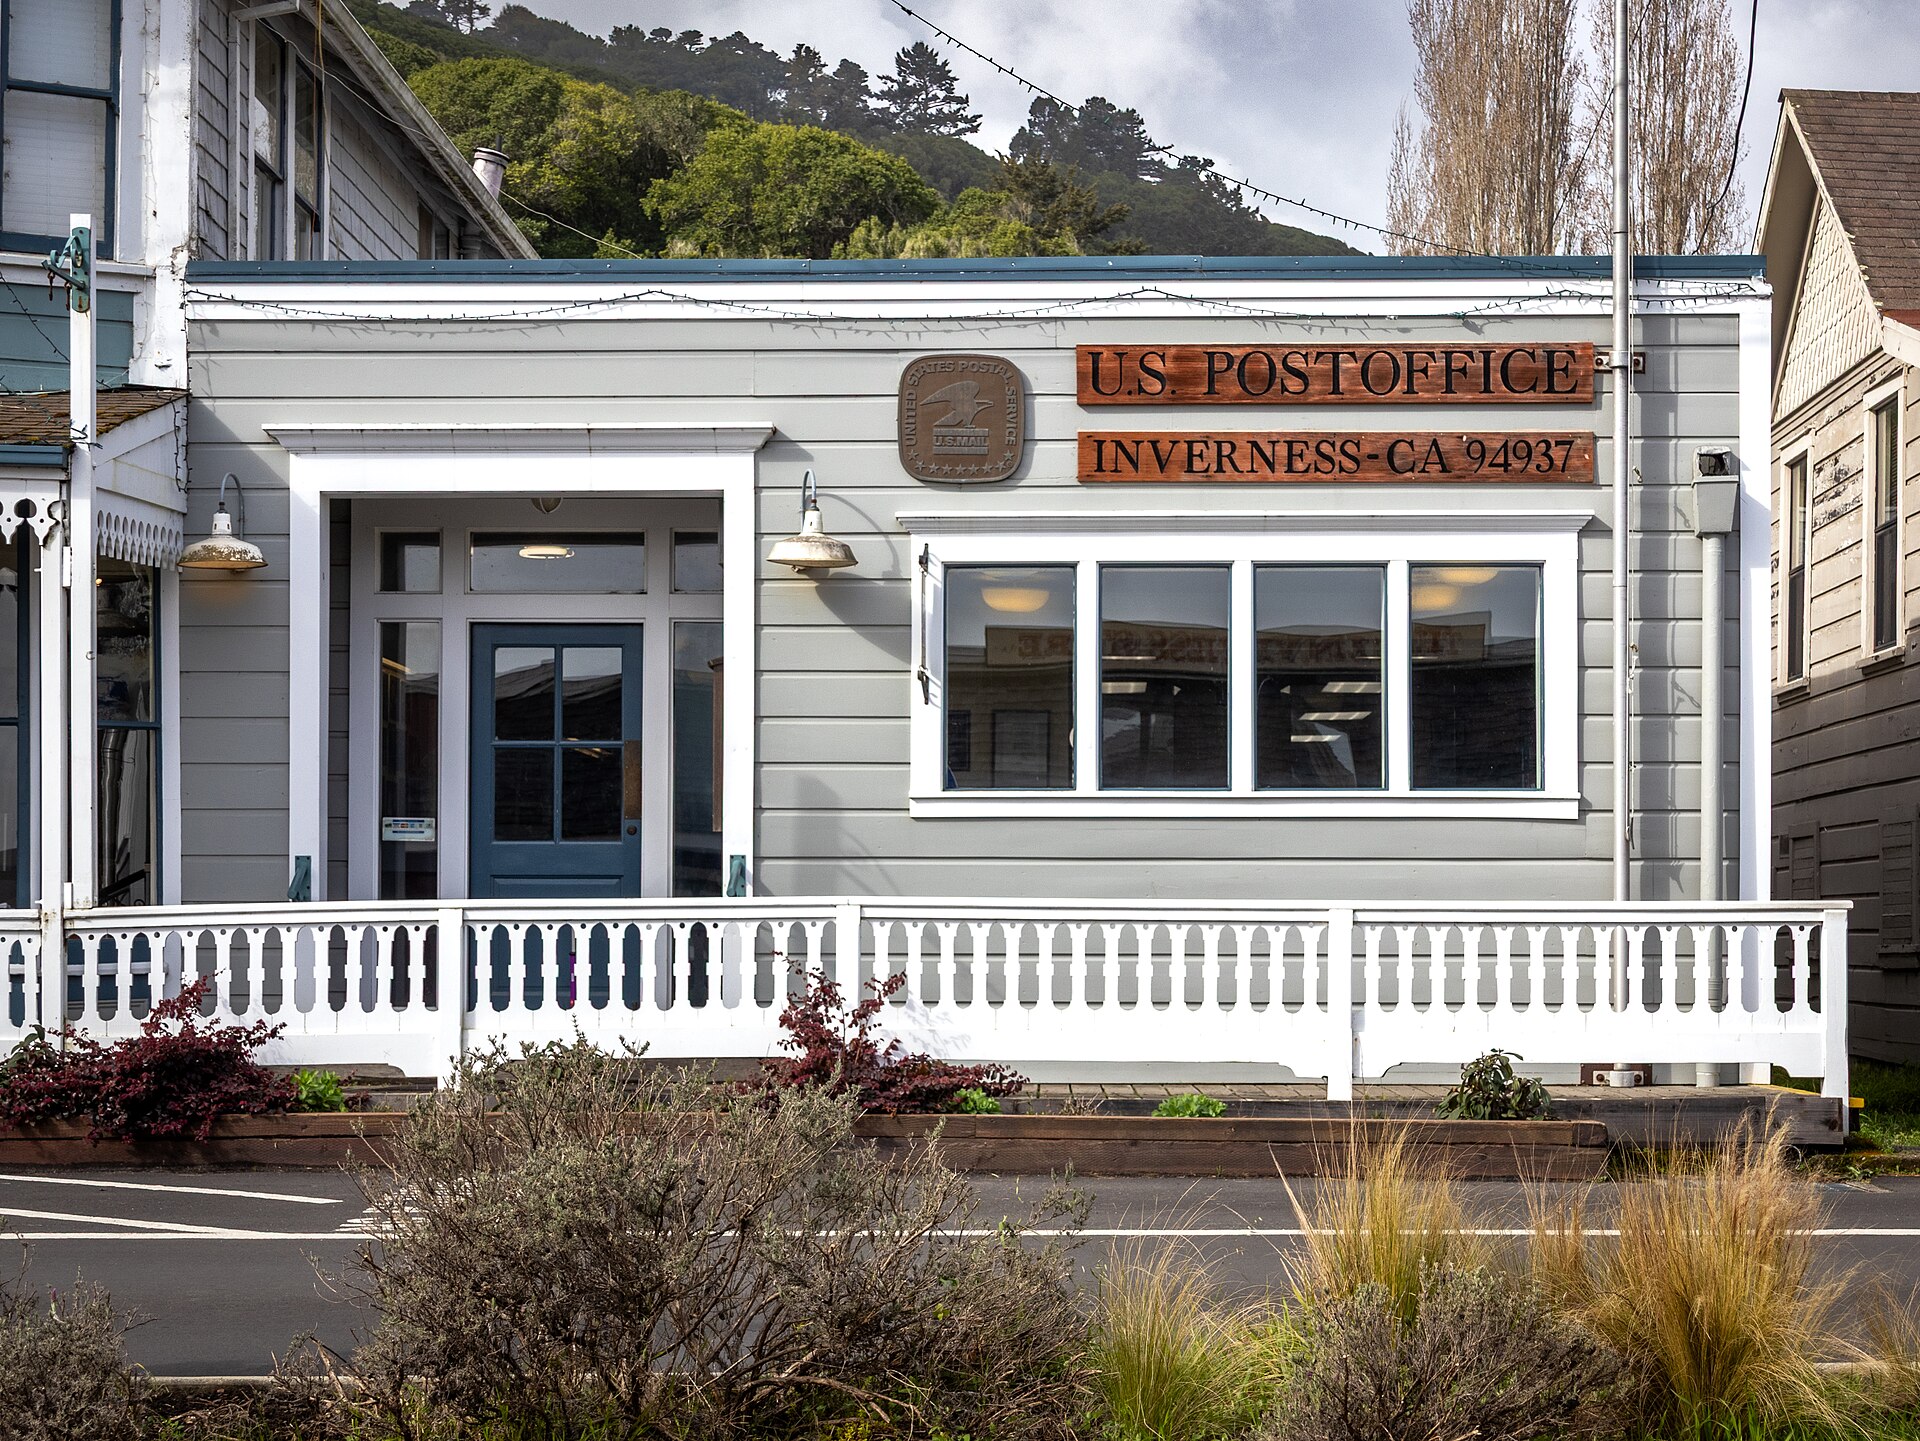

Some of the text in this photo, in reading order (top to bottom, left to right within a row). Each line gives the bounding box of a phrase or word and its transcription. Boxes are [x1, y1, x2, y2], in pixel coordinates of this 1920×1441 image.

[1088, 351, 1177, 396] U.S.
[905, 361, 1018, 447] UNITED STATES POSTAL SERVICE
[1466, 438, 1575, 474] 94937
